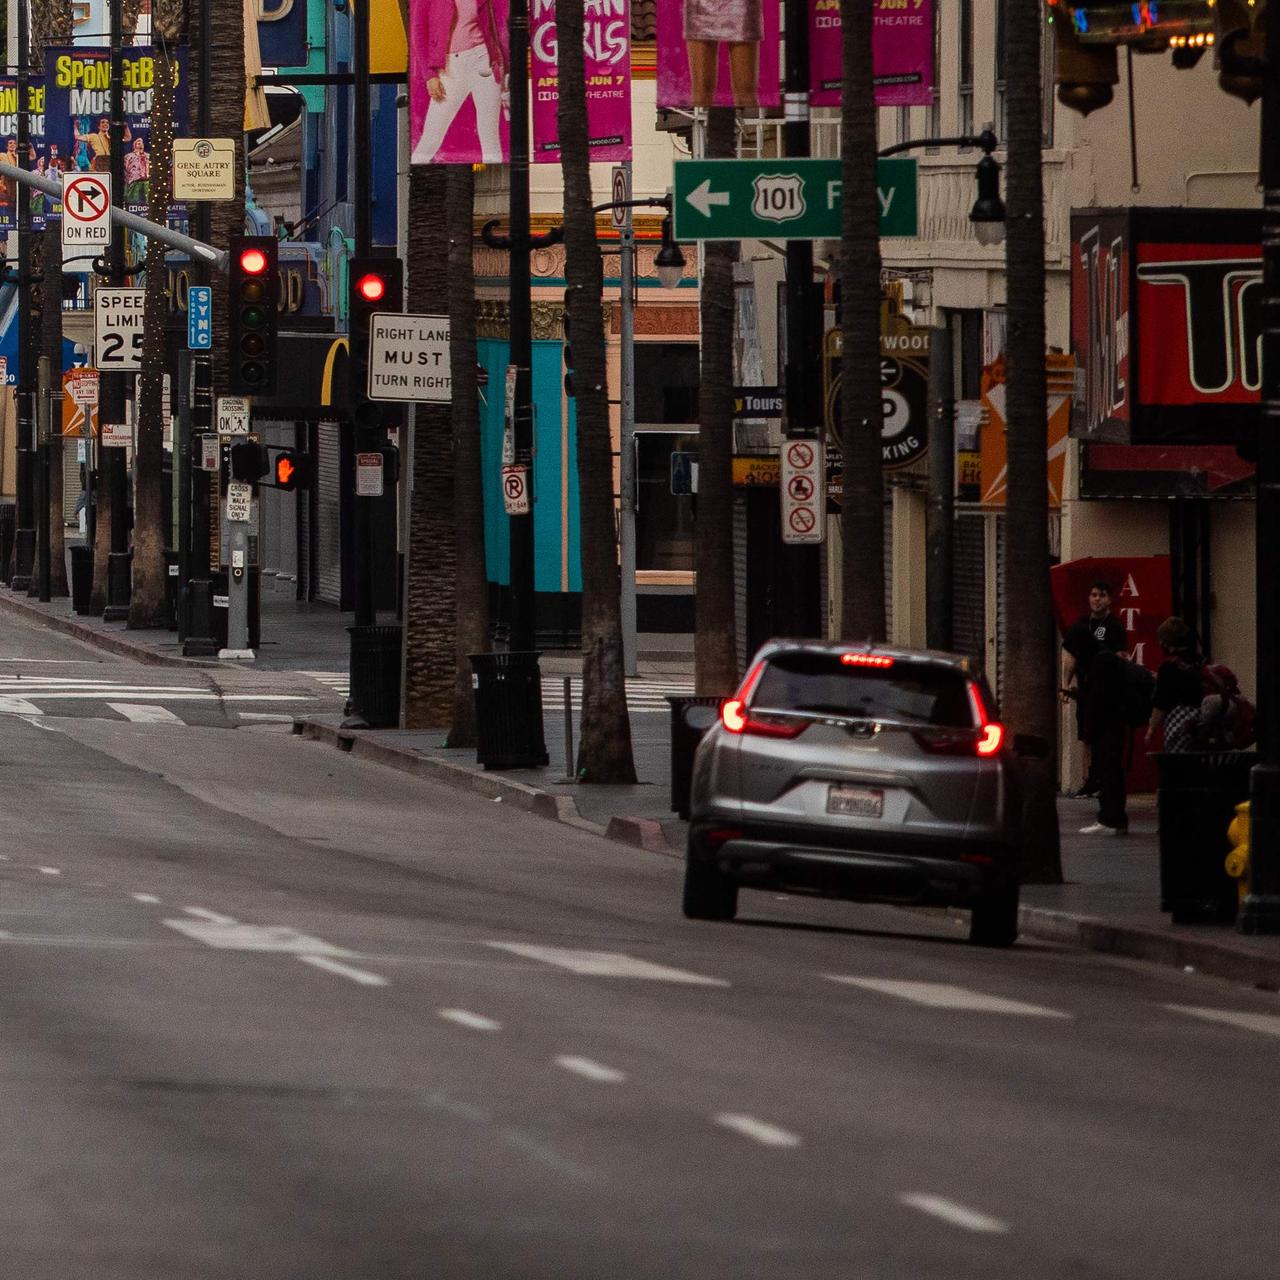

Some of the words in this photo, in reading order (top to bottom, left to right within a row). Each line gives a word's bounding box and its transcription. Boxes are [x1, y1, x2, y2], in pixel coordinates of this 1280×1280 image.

[533, 21, 628, 65] GRLS
[615, 76, 624, 85] 7
[176, 162, 200, 170] GENE
[203, 162, 231, 170] AUTRY
[761, 187, 795, 210] 101
[827, 180, 896, 217] Fy
[66, 227, 83, 238] ON
[86, 227, 107, 238] RED
[198, 291, 209, 345] SYNC
[376, 328, 415, 340] RIGHT
[419, 330, 451, 342] LANE
[384, 350, 443, 366] MUST
[374, 374, 408, 387] TURN
[413, 376, 452, 389] RIGHT
[745, 396, 783, 411] Tours
[219, 417, 231, 430] OK
[230, 485, 249, 493] CROSS
[231, 511, 245, 519] ONLY
